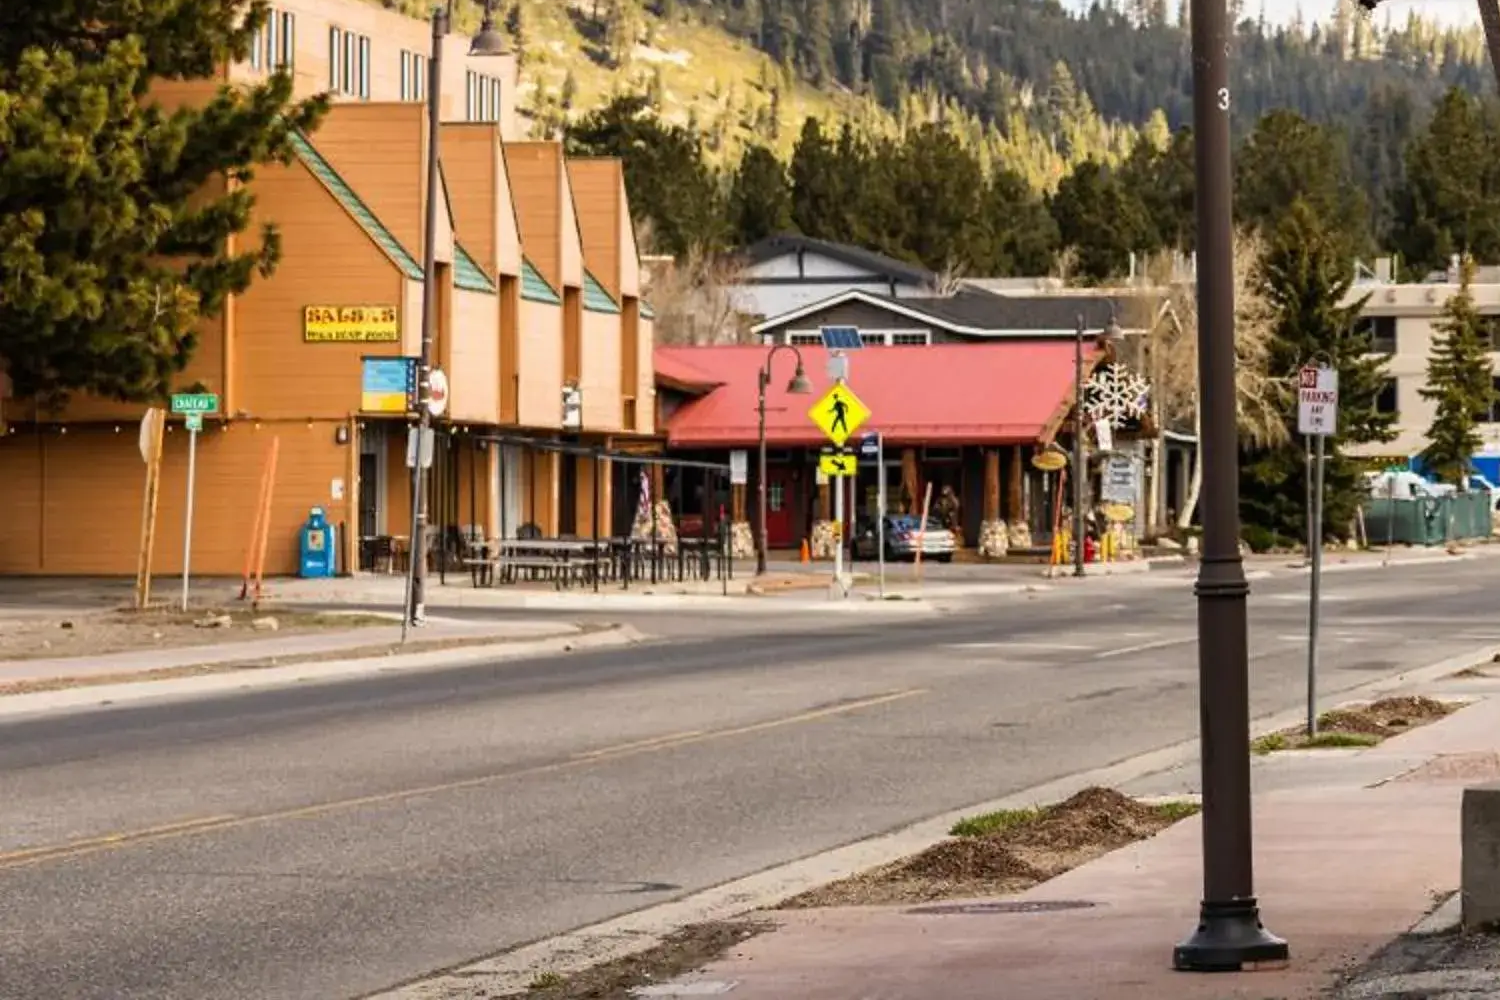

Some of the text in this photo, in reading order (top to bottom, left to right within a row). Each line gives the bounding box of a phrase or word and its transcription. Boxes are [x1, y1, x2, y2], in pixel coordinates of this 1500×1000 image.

[1216, 87, 1229, 110] 3
[1301, 370, 1316, 386] NO
[1301, 390, 1337, 403] PARKING
[1311, 404, 1325, 414] ANY
